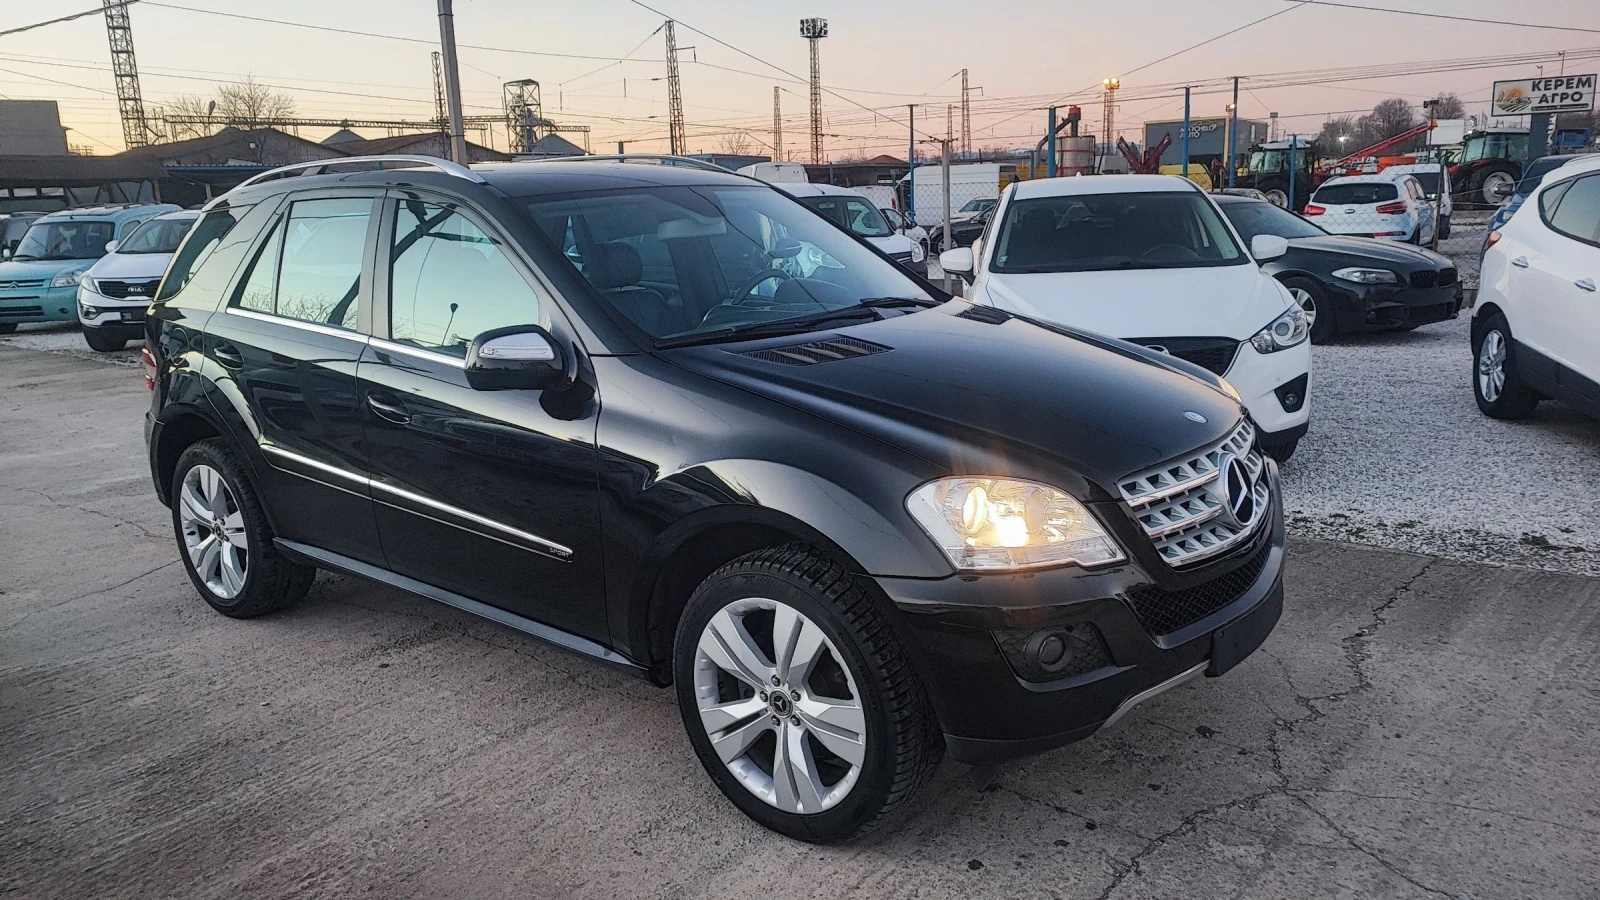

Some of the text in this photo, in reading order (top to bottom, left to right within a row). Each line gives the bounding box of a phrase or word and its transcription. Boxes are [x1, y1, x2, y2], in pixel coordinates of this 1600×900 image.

[1531, 77, 1592, 91] КЕРЕМ
[1538, 91, 1583, 104] АГРО
[549, 548, 569, 557] SPORT
